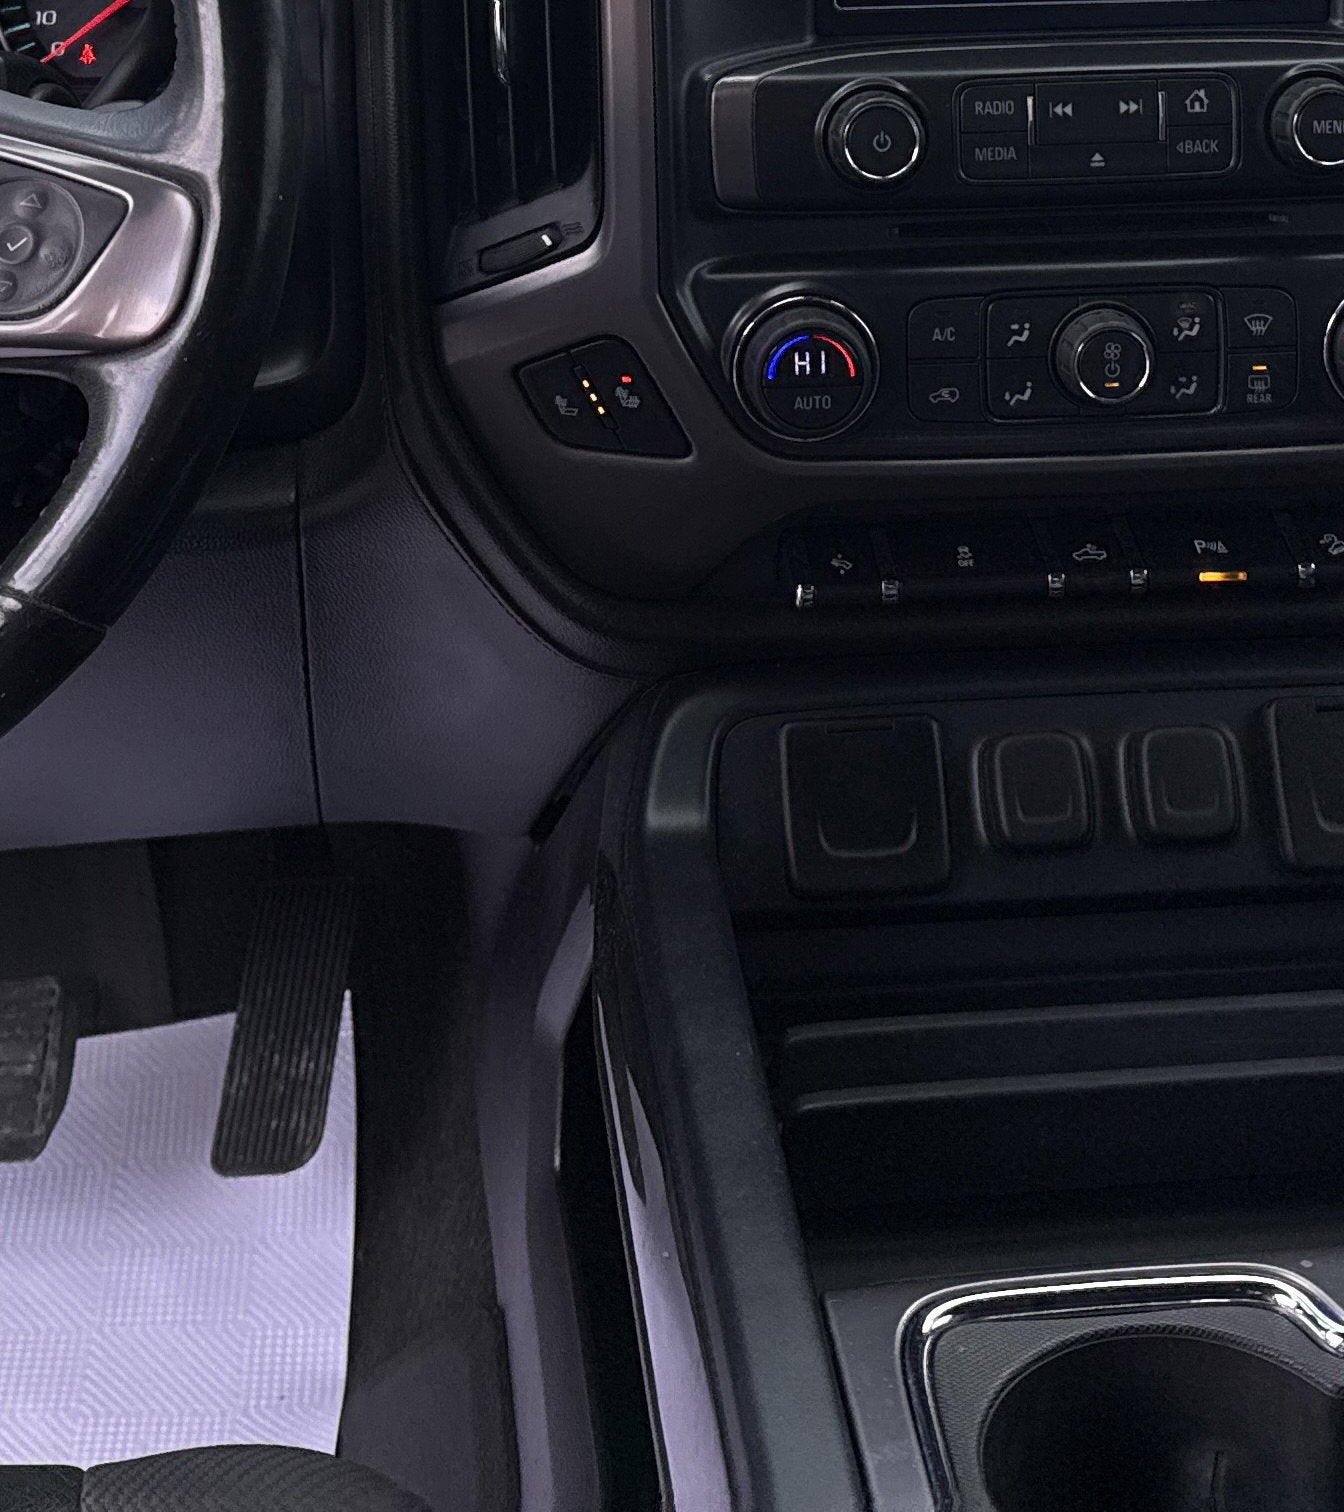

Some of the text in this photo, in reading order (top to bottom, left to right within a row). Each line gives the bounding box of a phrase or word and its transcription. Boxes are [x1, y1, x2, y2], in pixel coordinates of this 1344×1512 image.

[35, 10, 57, 26] 10
[974, 99, 1015, 118] RADIO
[974, 145, 1017, 164] MEDIA
[1184, 137, 1219, 155] BACK
[932, 326, 956, 344] A/C
[793, 394, 832, 413] AUTO
[1246, 393, 1272, 405] REAR
